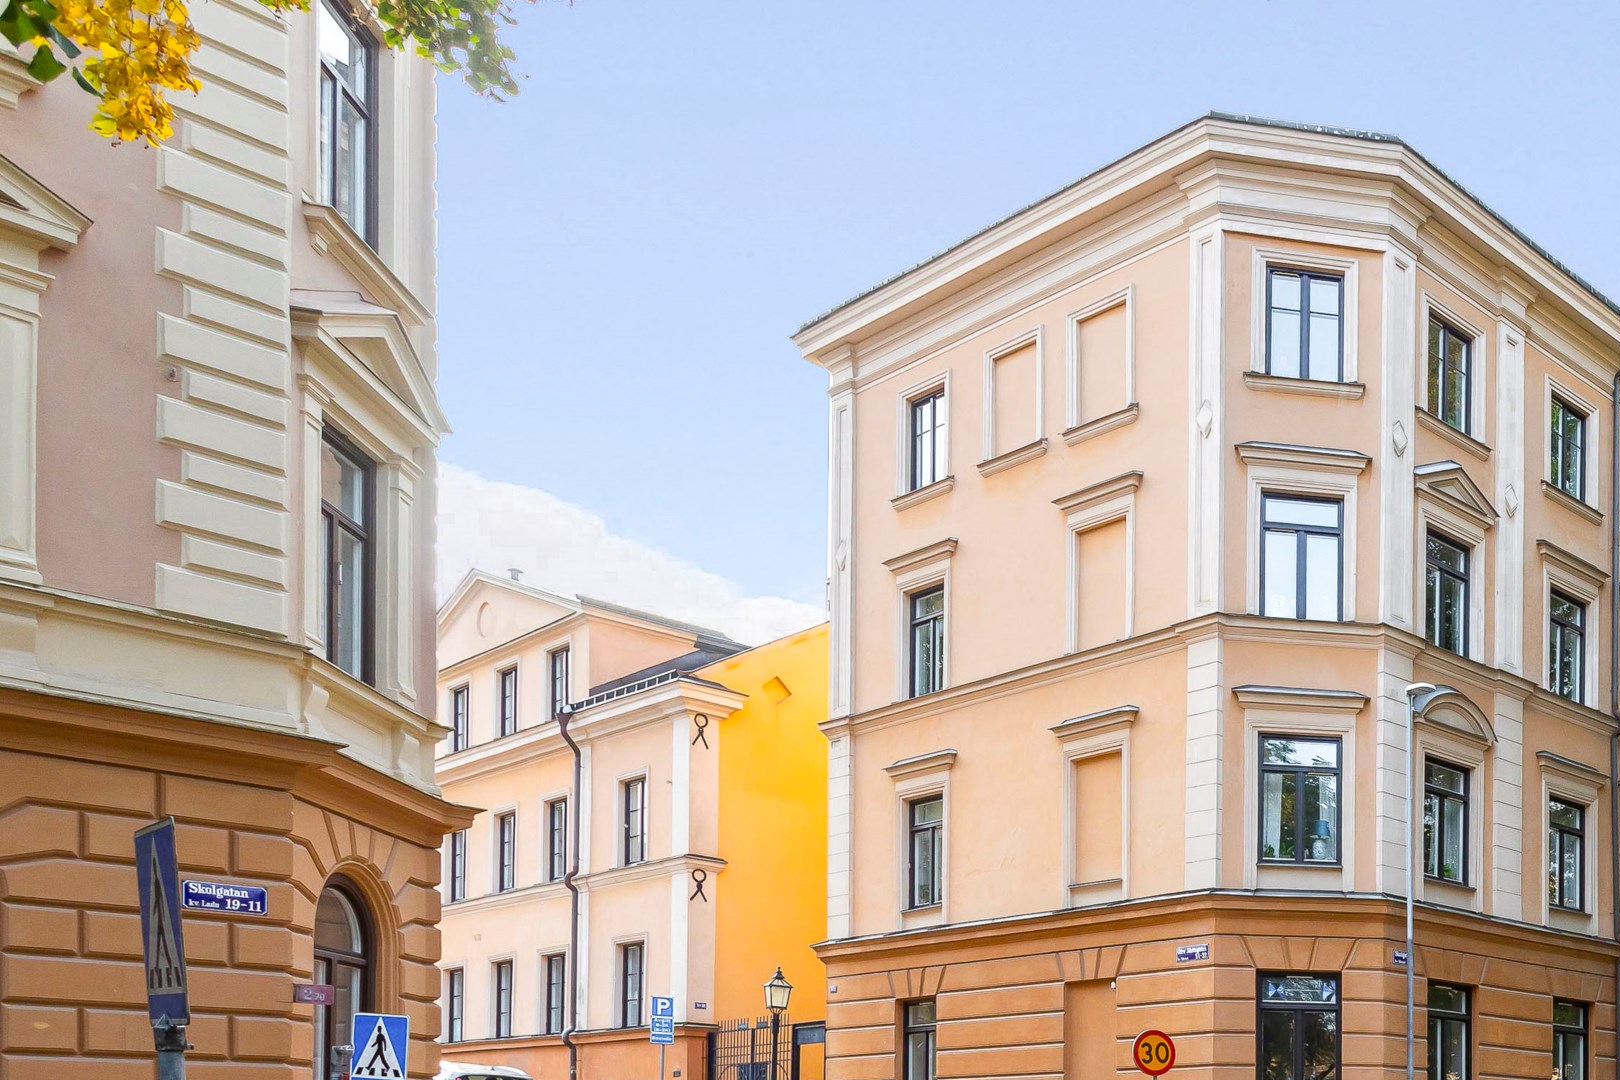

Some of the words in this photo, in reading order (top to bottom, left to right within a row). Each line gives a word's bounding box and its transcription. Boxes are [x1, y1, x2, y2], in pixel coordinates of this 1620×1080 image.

[189, 882, 249, 899] Skolgatan
[225, 898, 262, 912] 19-11
[657, 998, 670, 1015] P
[1141, 1041, 1169, 1064] 30
